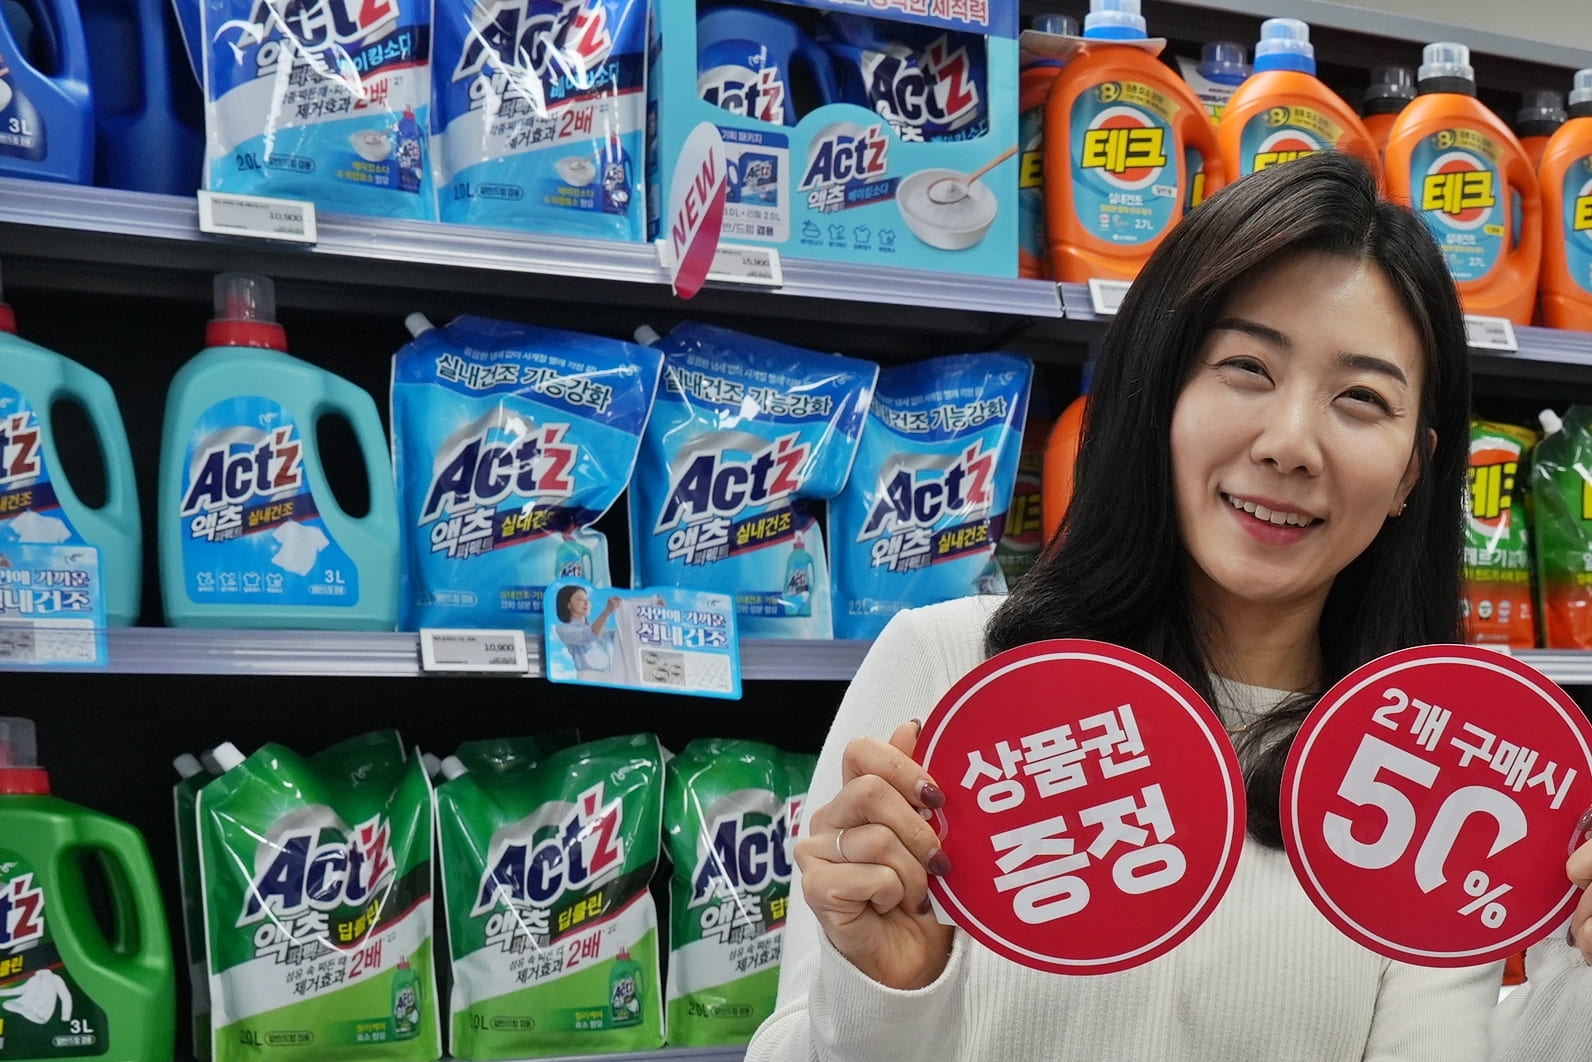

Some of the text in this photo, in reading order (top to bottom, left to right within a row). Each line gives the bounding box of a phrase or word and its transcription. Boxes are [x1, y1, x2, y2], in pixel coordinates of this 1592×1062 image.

[8, 119, 33, 137] 3L
[558, 106, 594, 138] 2배
[1081, 126, 1168, 174] 테크
[672, 146, 716, 261] NEW
[1422, 169, 1497, 216] 테크
[435, 353, 612, 414] 실내건조 기능강화
[664, 365, 833, 417] 실내건조 기능강화
[931, 399, 1007, 432] 기능강화
[191, 501, 293, 541] 액츠 실내건조
[430, 507, 495, 558] 액츠
[668, 512, 792, 563] 액츠 실내건조
[872, 524, 990, 571] 액츠 실내건조
[36, 569, 91, 588] 가까운
[324, 568, 346, 584] 3L
[636, 606, 727, 628] 자연에 가까운
[637, 621, 729, 649] 실내건조
[958, 702, 1153, 815] 상품권
[1371, 686, 1579, 811] 2개 구매시
[991, 782, 1189, 925] 증정
[253, 910, 330, 964] 액츠
[484, 894, 603, 953] 액츠 딥클린
[293, 938, 383, 996] 제거효과 2배
[514, 932, 601, 984] 제거효과 2배
[69, 1018, 94, 1034] 3L
